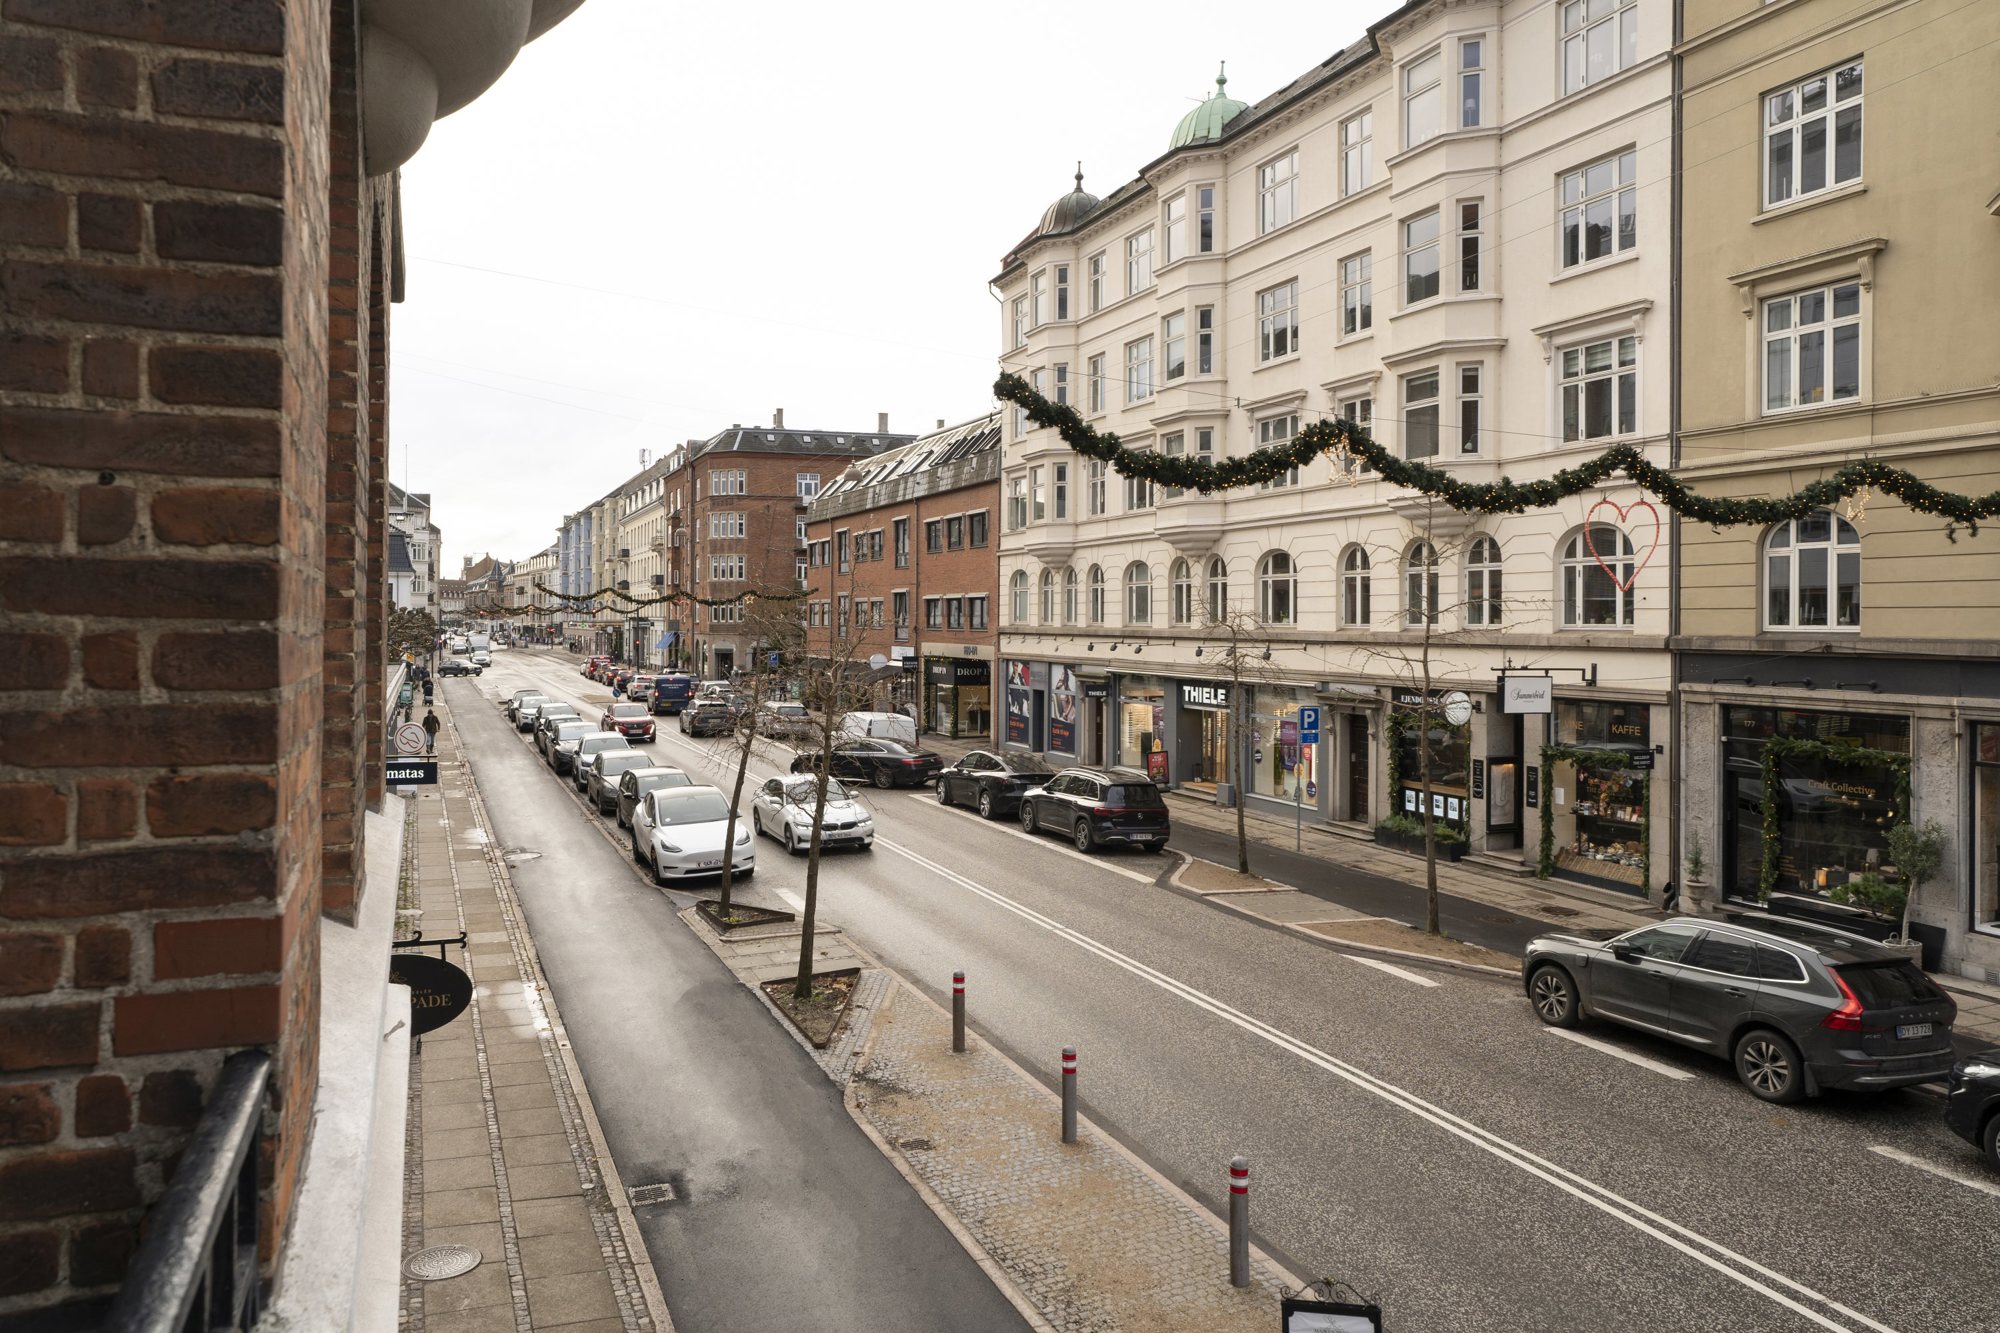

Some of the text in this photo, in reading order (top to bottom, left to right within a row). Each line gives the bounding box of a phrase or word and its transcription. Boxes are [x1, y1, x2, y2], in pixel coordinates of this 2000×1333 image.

[957, 668, 981, 676] DROP
[1183, 685, 1226, 705] THIELE
[1304, 710, 1316, 729] P
[1743, 720, 1756, 728] 177
[1611, 724, 1641, 736] KAFFE
[386, 769, 425, 779] matas
[1807, 779, 1876, 795] Craft Collective
